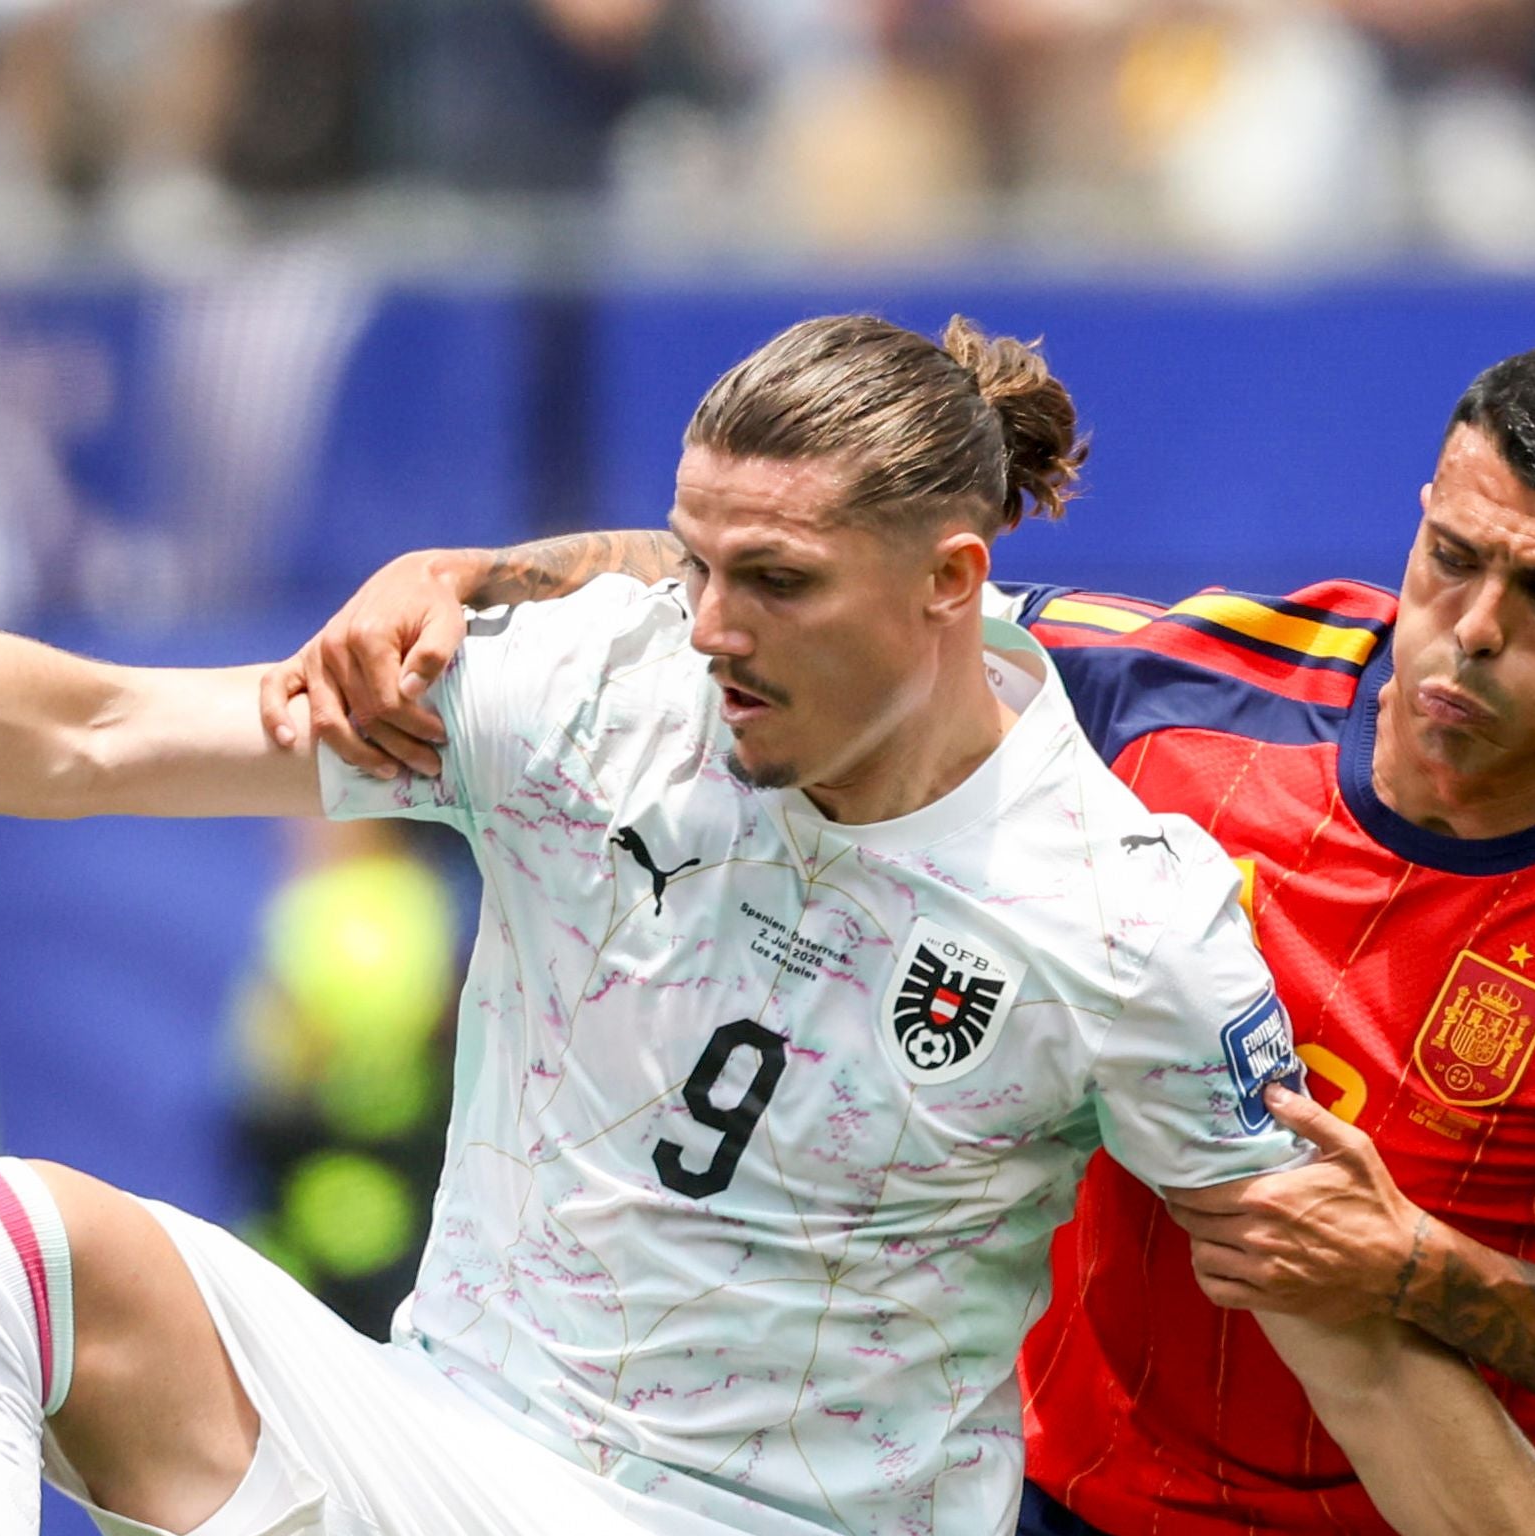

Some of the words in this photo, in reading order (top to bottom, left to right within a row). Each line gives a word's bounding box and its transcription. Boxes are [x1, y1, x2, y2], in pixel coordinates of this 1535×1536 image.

[740, 902, 787, 933] Spanien
[791, 930, 847, 964] Österrech
[751, 940, 771, 958] Los
[772, 953, 818, 982] Angeles
[792, 948, 824, 968] 2026
[942, 940, 990, 971] ÖFB
[652, 1017, 790, 1199] 9
